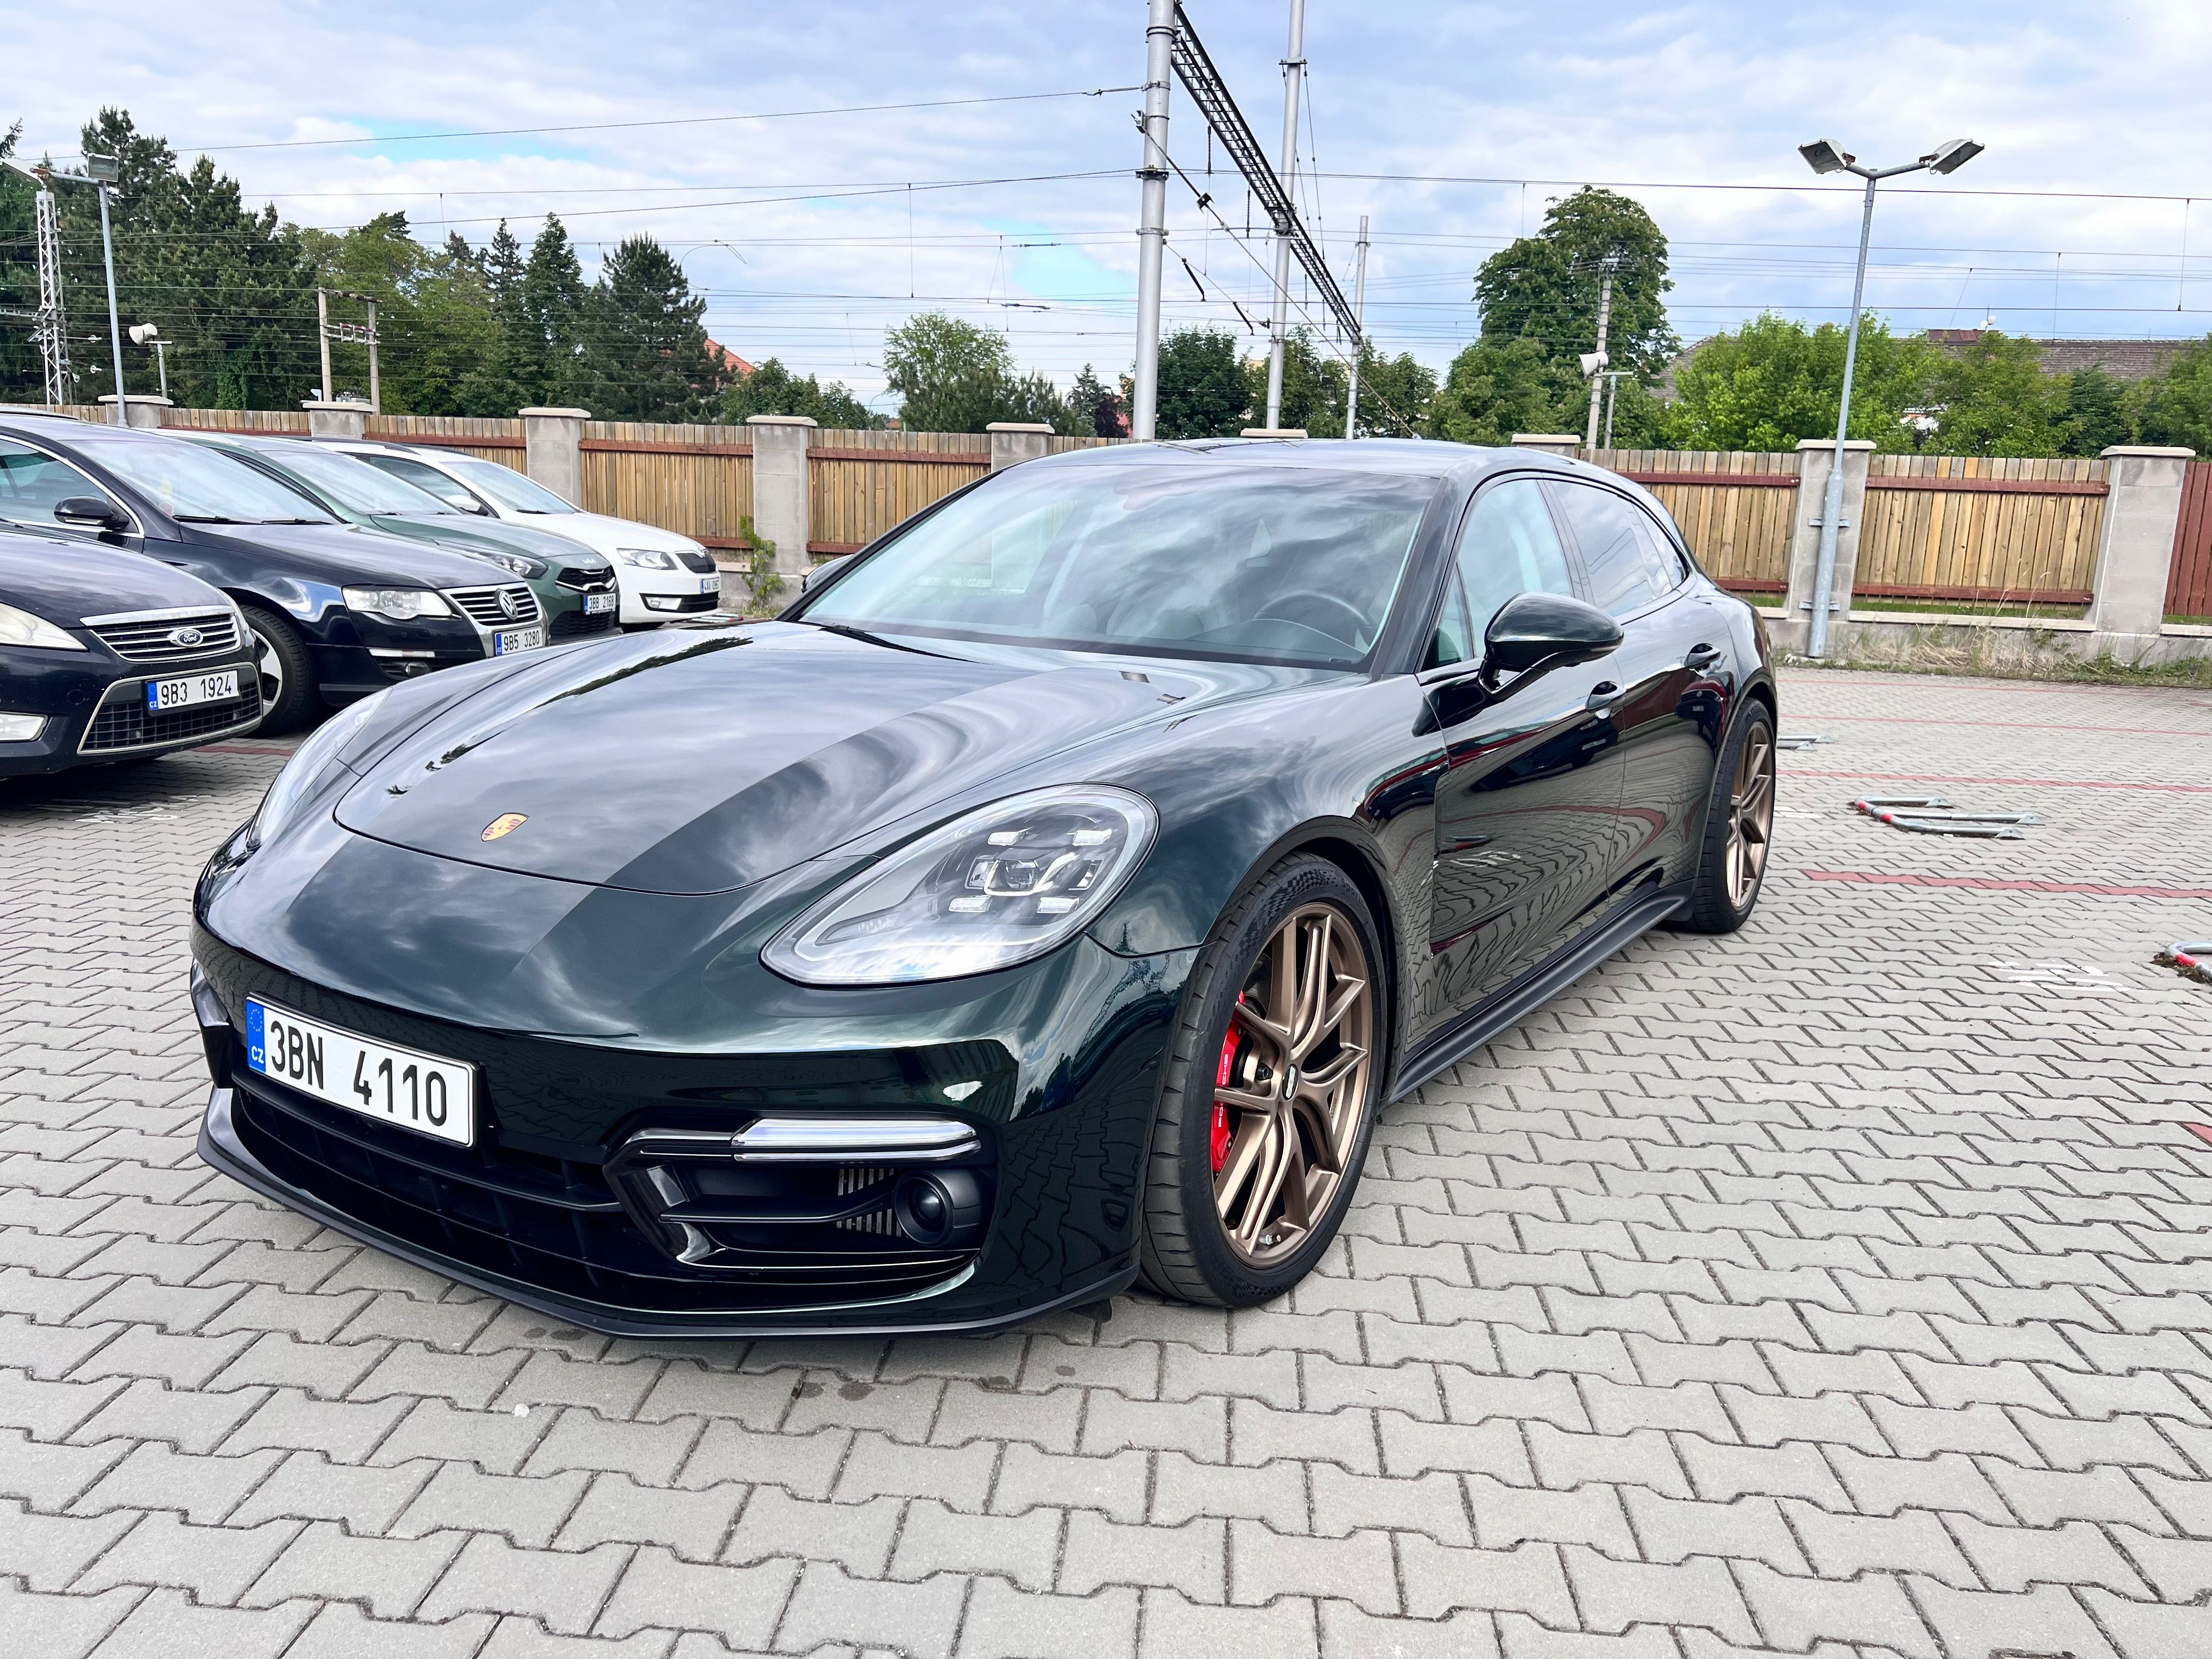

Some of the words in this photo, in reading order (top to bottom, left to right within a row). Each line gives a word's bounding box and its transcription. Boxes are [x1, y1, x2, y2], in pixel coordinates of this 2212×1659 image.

[589, 597, 599, 610] 3BB
[183, 633, 197, 642] Ford
[504, 634, 518, 651] 9B5
[524, 630, 539, 647] 3280
[161, 682, 188, 706] 9B3
[200, 675, 232, 699] 1924
[251, 1045, 264, 1064] CZ
[270, 1020, 324, 1090] 3BN
[354, 1050, 447, 1126] 4110
[1218, 1054, 1228, 1128] POCHE
